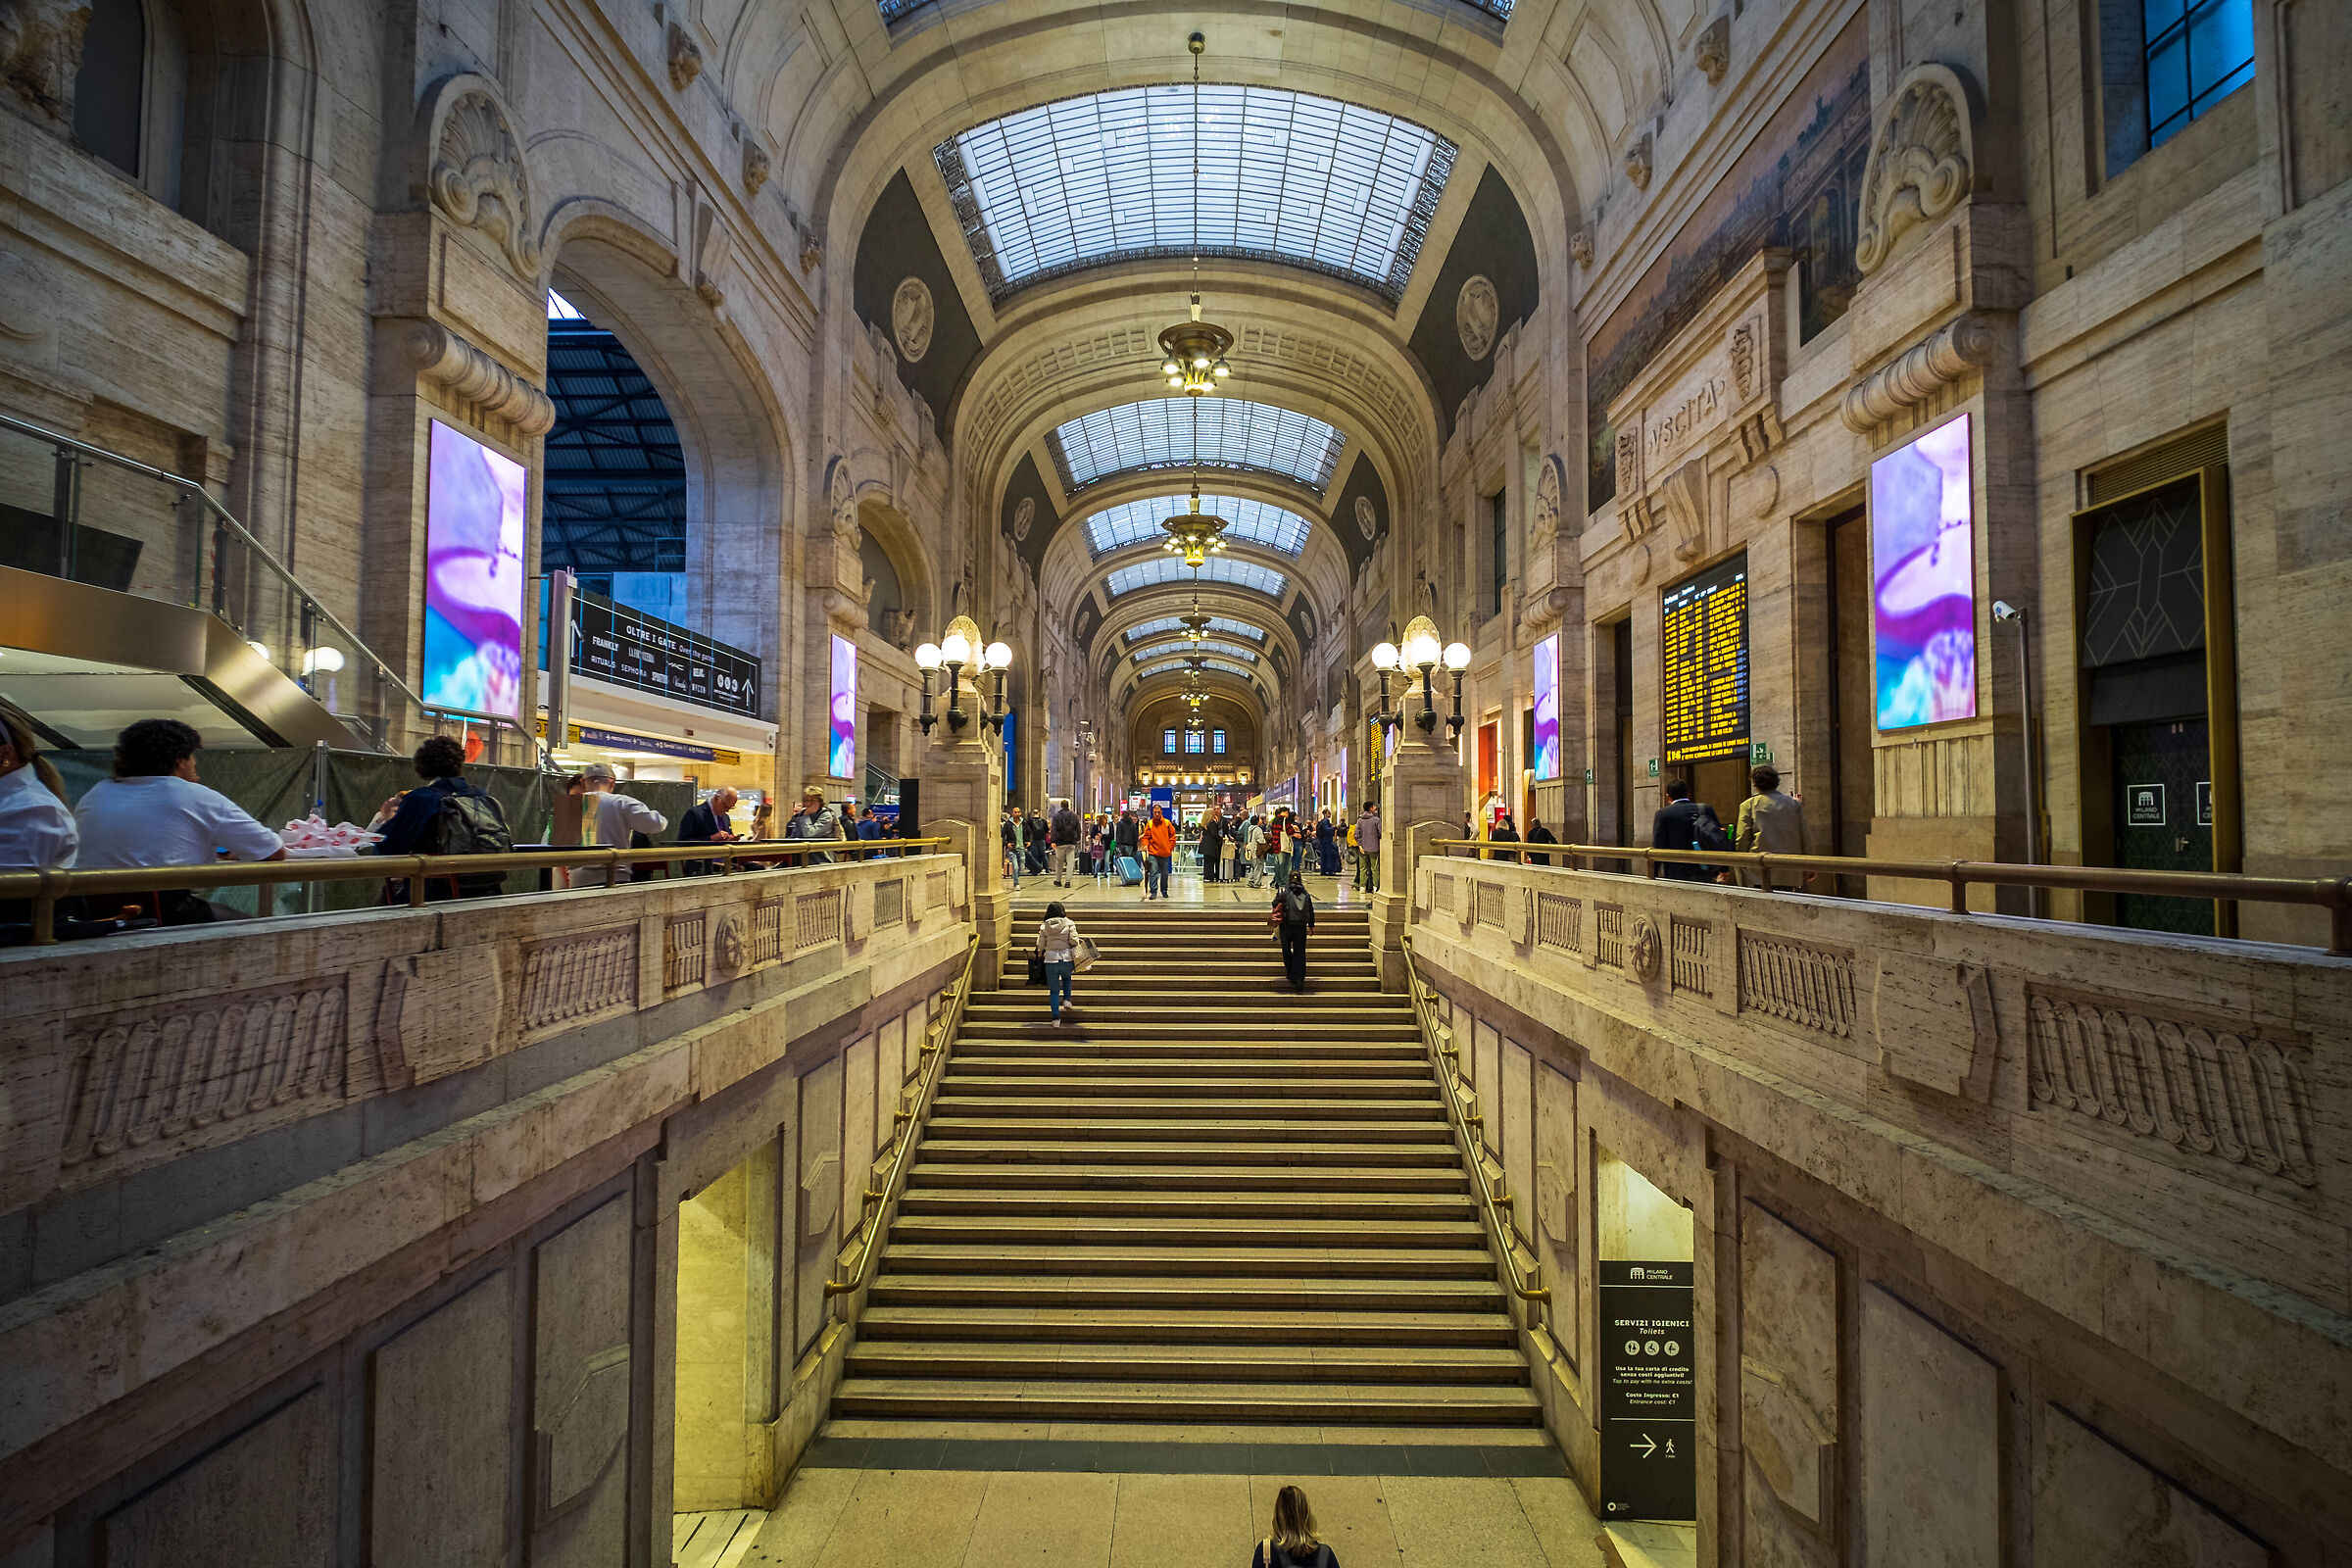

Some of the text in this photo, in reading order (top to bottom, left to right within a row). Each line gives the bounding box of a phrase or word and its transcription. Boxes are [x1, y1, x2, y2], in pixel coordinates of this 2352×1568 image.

[592, 636, 619, 652] FRANKLY
[626, 625, 651, 641] OLTRE
[652, 634, 657, 643] I
[658, 636, 676, 650] GATE
[591, 655, 616, 668] RITUALS
[620, 663, 647, 677] SEPHORA
